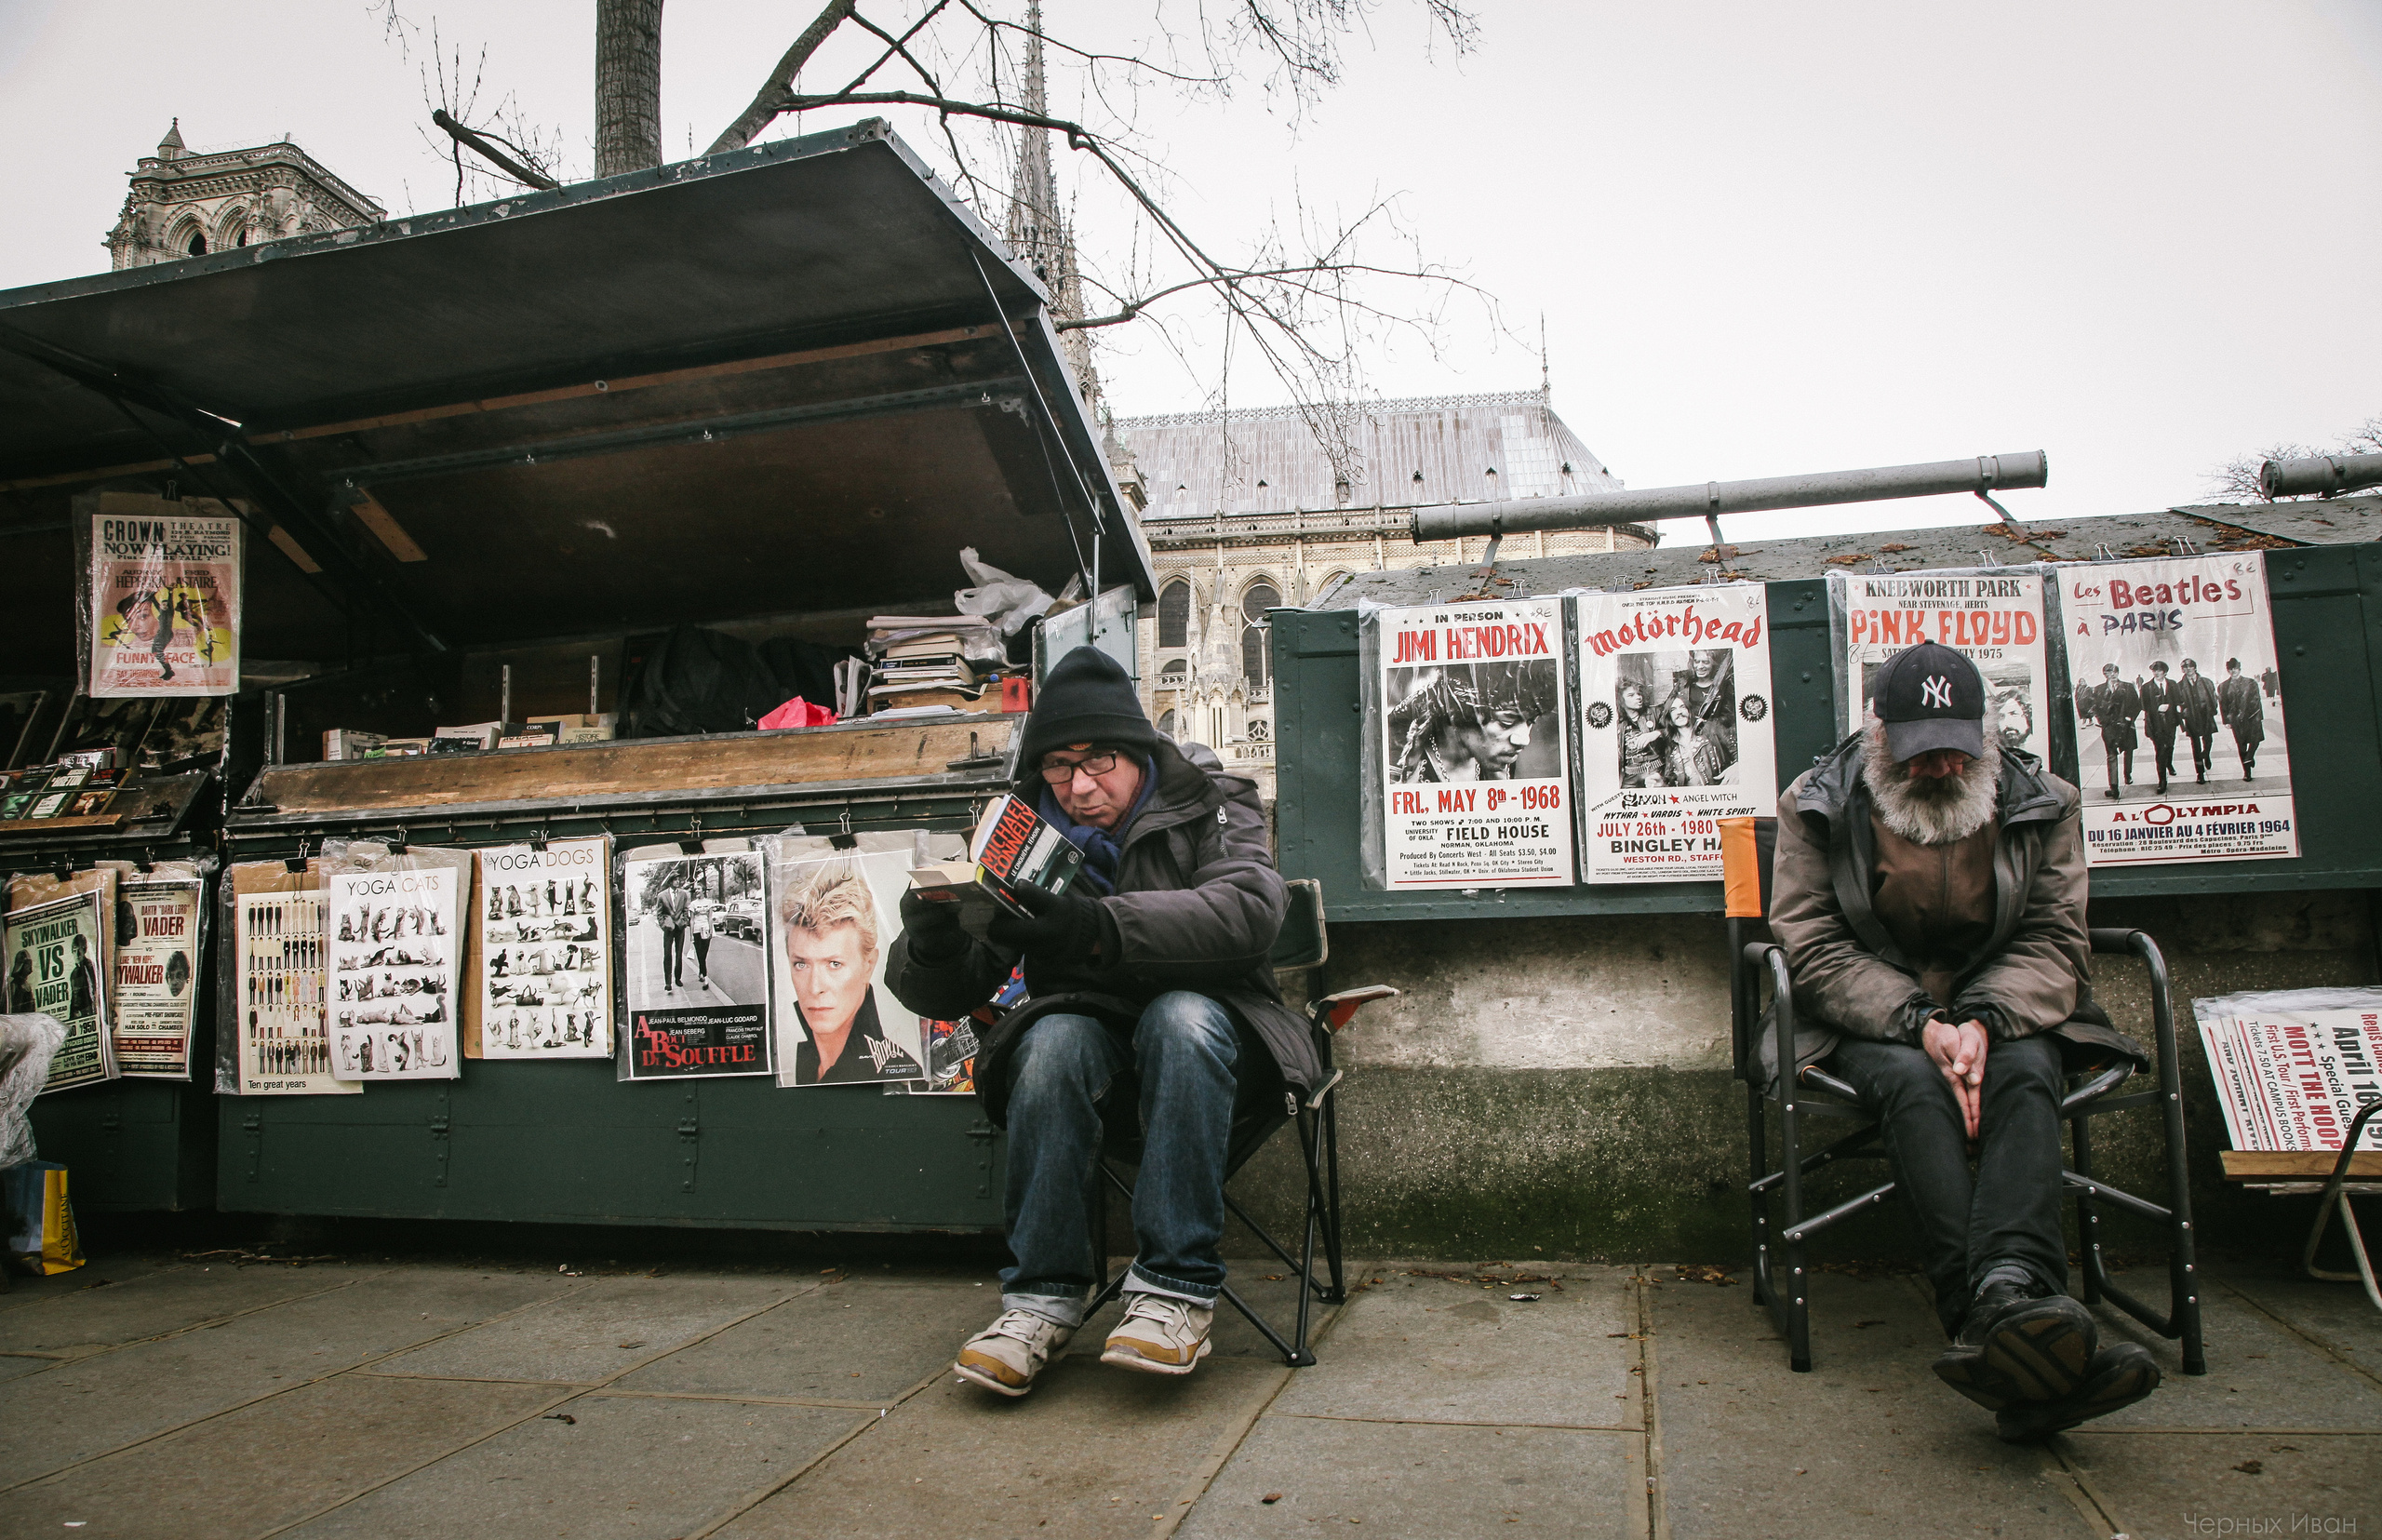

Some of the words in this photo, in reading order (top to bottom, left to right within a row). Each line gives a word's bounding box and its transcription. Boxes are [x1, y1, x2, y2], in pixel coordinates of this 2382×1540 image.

[104, 520, 164, 542] CROWN
[104, 543, 147, 555] NOW
[152, 544, 231, 556] PLAYING!
[176, 577, 218, 588] ASTAIRE
[1866, 580, 1970, 596] KNEBWORTH
[1976, 580, 2021, 596] PARK
[2074, 582, 2100, 599] Les
[2109, 575, 2241, 609] Beatles
[1898, 600, 1917, 609] NEAR
[1920, 600, 1961, 609] STEVENAGE,
[1965, 600, 1987, 609] HERTS
[1436, 615, 1448, 623] IN
[1454, 611, 1504, 622] PERSON
[2100, 609, 2183, 636] PARIS
[1584, 605, 1761, 657] motörhead
[1938, 611, 2037, 646] FLOYD
[1393, 630, 1436, 663] JIMI
[1447, 623, 1548, 659] HENDRIX
[1979, 649, 2002, 659] 1975
[116, 652, 156, 663] FUNNY
[165, 652, 195, 663] FACE
[1921, 676, 1952, 708] NY
[1393, 791, 1429, 814] FRI.,
[1439, 789, 1477, 812] MAY
[1488, 788, 1506, 810] 8th
[1520, 785, 1560, 810] 1968
[1591, 802, 1604, 811] WITH
[1603, 792, 1624, 805] GUESTS
[1711, 794, 1737, 802] WITCH
[1604, 811, 1639, 820] MYTHRA
[2112, 812, 2127, 822] A
[980, 799, 1025, 869] MICHAEL
[1447, 827, 1490, 840] FIELD
[1498, 824, 1549, 838] HOUSE
[1597, 823, 1630, 837] JULY
[1637, 822, 1666, 837] 26th
[1681, 820, 1713, 835] 1980
[2088, 830, 2105, 842] DU
[2108, 829, 2121, 841] 16
[2124, 826, 2173, 840] JANVIER
[2176, 825, 2191, 837] AU
[2196, 825, 2203, 836] 4
[2207, 822, 2255, 836] FÉVRIER
[2258, 820, 2290, 833] 1964
[993, 805, 1037, 877] CONNELLY
[1611, 838, 1696, 853] BINGLEY
[491, 854, 541, 871] YOGA
[546, 849, 594, 867] DOGS
[347, 880, 396, 896] YOGA
[402, 876, 439, 892] CATS
[21, 918, 78, 948] SKYWALKER
[143, 917, 185, 936] VADER
[39, 944, 64, 981] VS
[35, 981, 69, 1008] VADER
[2248, 1021, 2263, 1049] Tickets
[2265, 1024, 2280, 1044] First
[666, 1045, 756, 1067] SOUFFLE
[2270, 1044, 2287, 1062] U.S.
[2283, 1026, 2316, 1067] MOTT
[2332, 1027, 2375, 1075] April
[2257, 1049, 2271, 1068] 7.50
[2263, 1069, 2275, 1080] AT
[2277, 1062, 2292, 1082] Tour
[248, 1080, 261, 1089] Ten
[264, 1080, 283, 1090] great
[286, 1080, 306, 1090] years
[2299, 1071, 2326, 1100] THE
[2319, 1056, 2348, 1096] Special
[2335, 1099, 2352, 1134] Gues
[2268, 1081, 2287, 1118] CAMPUS
[2285, 1089, 2302, 1111] First
[2279, 1118, 2297, 1151] BOOKS
[60, 1193, 71, 1259] L'OCCITANE
